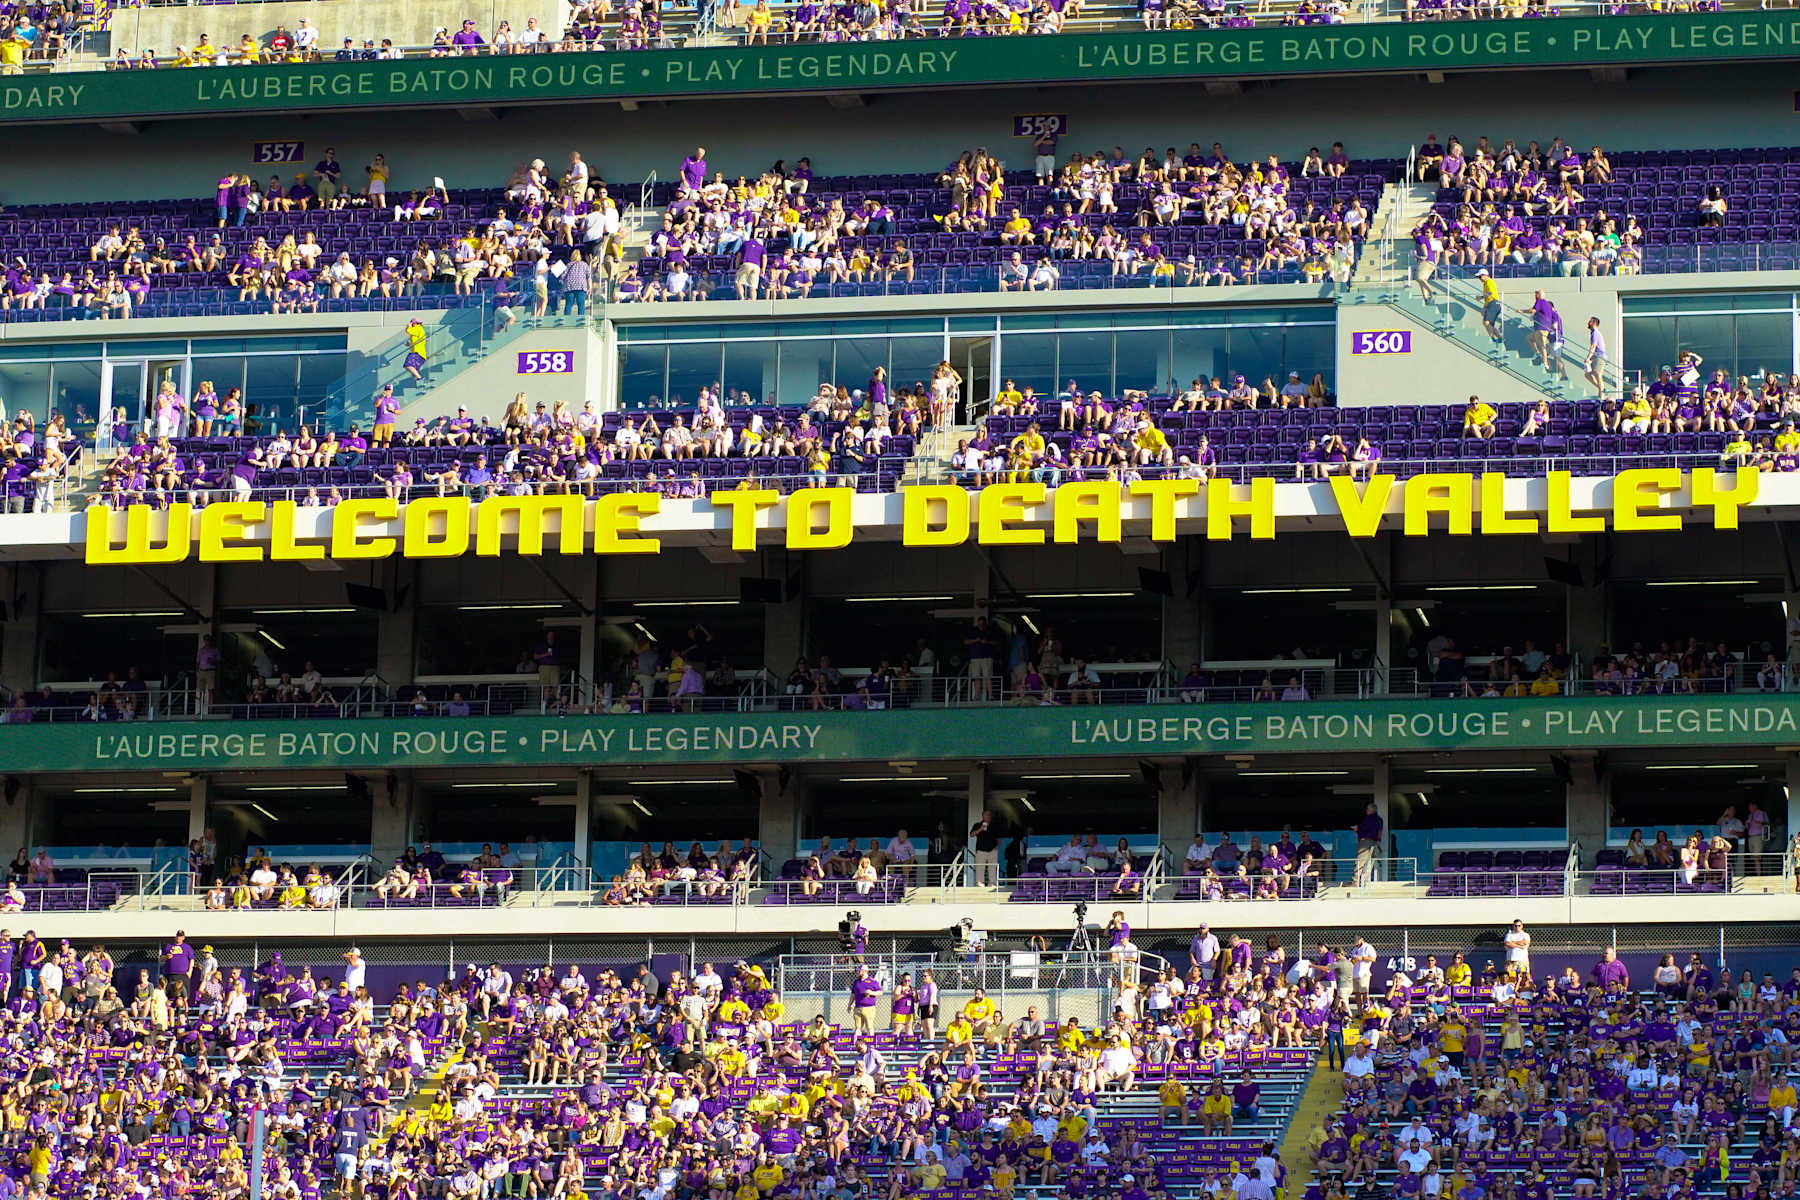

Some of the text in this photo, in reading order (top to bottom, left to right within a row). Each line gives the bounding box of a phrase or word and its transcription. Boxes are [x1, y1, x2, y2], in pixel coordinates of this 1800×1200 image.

[1079, 40, 1265, 67] L'AUBERGE
[1282, 36, 1390, 61] BATON
[1408, 31, 1530, 56] ROUGE
[1574, 27, 1653, 51] PLAY
[197, 51, 957, 100] L'AUBERGE BATON ROUGE PLAY LEGENDARY
[4, 85, 84, 109] DARY
[1021, 116, 1061, 136] 559
[261, 143, 298, 162] 557
[1360, 332, 1403, 354] 560
[525, 352, 567, 373] 558
[84, 466, 1760, 564] WELCOME TO DEATH VALLEY
[1071, 707, 1798, 743] L'AUBERGE BATON ROUGE PLAY LEGENDA
[96, 725, 821, 759] L'AUBERGE BATON ROUGE PLAY LEGENDARY
[1386, 956, 1417, 972] 418
